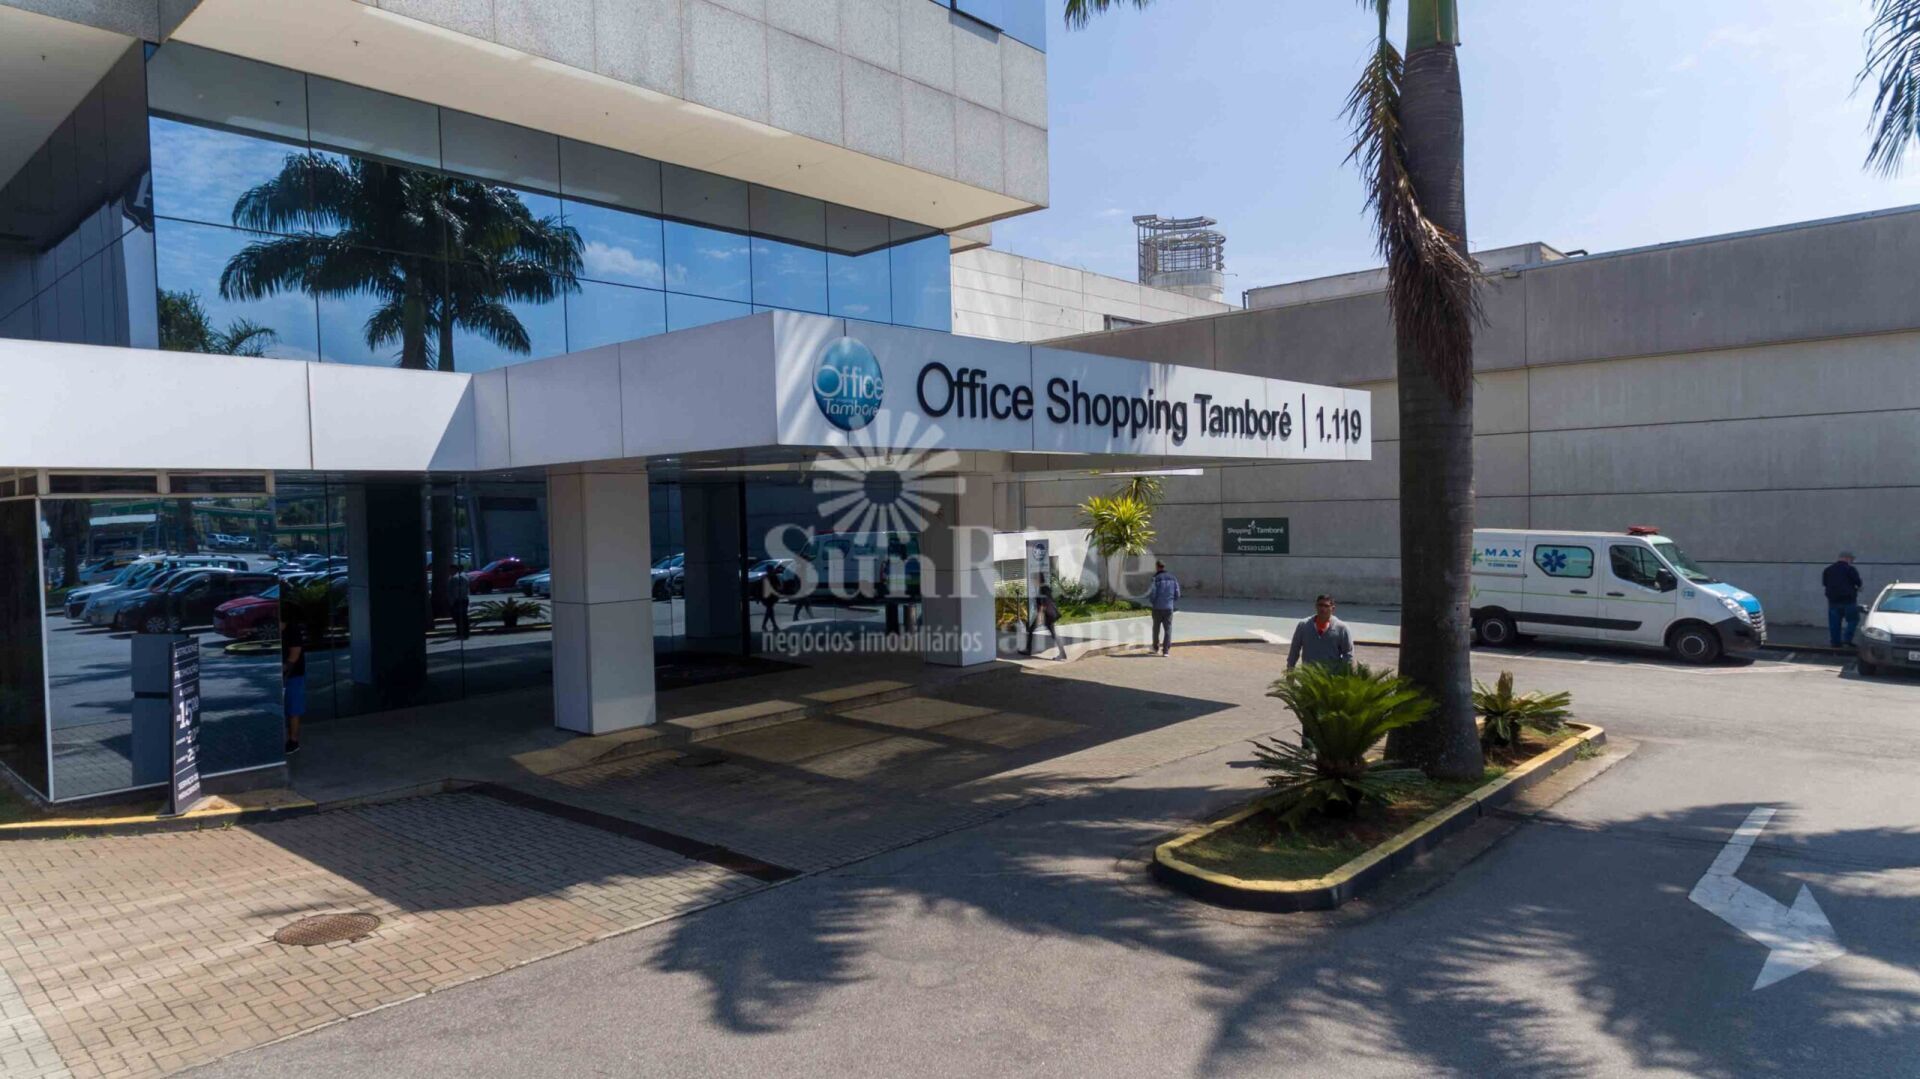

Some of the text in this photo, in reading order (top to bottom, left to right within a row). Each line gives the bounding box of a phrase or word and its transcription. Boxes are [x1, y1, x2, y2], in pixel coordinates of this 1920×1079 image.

[813, 364, 884, 400] Office
[823, 398, 879, 416] Tamboré
[917, 361, 1362, 445] Office Shopping Tamboré 1.119
[1227, 527, 1252, 535] Shopping
[1485, 548, 1521, 558] MAX
